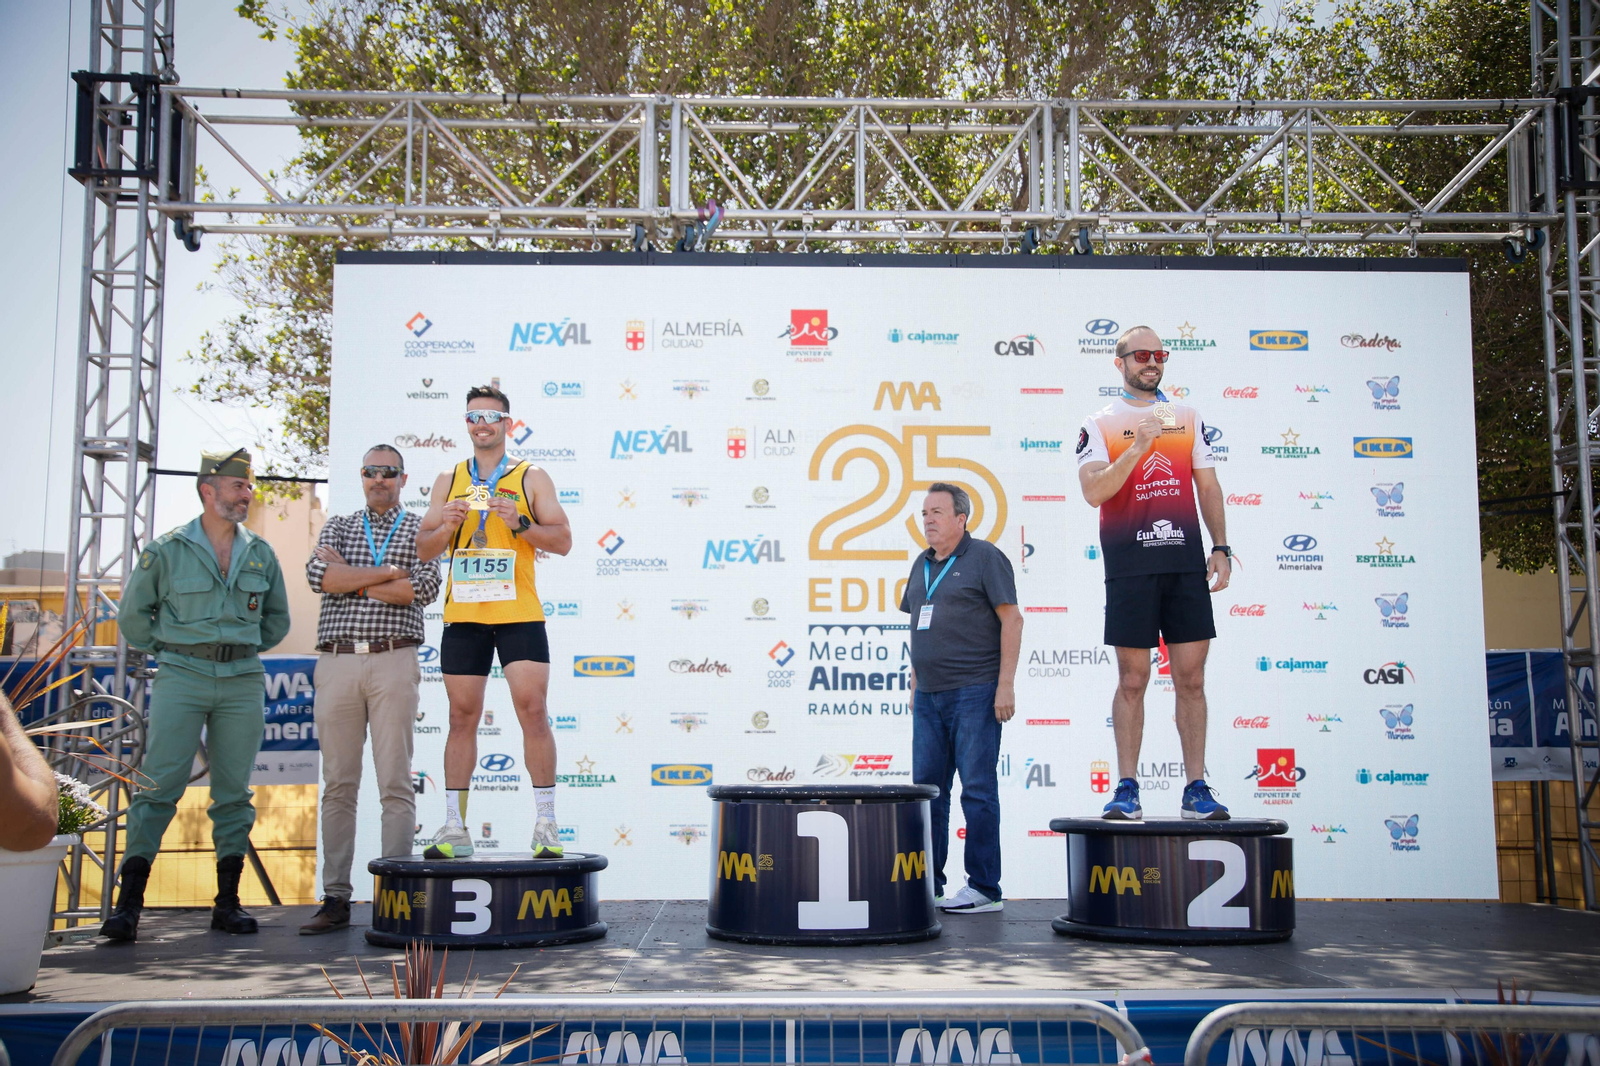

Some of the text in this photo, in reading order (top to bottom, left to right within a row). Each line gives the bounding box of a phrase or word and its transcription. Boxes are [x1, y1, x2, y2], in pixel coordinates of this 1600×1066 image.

[662, 319, 744, 337] ALMERÍA
[509, 317, 592, 351] NEXAL
[907, 329, 960, 345] cajamar
[404, 339, 475, 349] COOPERACIÓN
[661, 339, 704, 349] CIUDAD
[1257, 335, 1303, 345] IKEA
[993, 341, 1035, 356] CASI
[404, 350, 428, 358] 2005
[406, 391, 449, 400] vellsam
[610, 424, 693, 459] NEXAL
[1261, 446, 1321, 455] ESTRELLA
[1361, 443, 1406, 453] IKEA
[808, 424, 1009, 561] 25
[702, 534, 786, 569] NEXAL
[596, 558, 667, 567] COOPERACIÓN
[1276, 554, 1324, 562] HYUNDAI
[1356, 555, 1416, 564] ESTRELLA
[460, 558, 508, 574] 1155
[1278, 563, 1323, 571] Almerialva
[596, 568, 620, 576] 2005
[809, 641, 889, 661] Medio
[1028, 647, 1110, 665] ALMERÍA
[582, 662, 628, 672] IKEA
[1276, 658, 1328, 672] cajamar
[1028, 668, 1070, 678] CIUDAD
[1363, 668, 1404, 684] CASI
[768, 680, 792, 688] 2005
[808, 700, 910, 715] RAMÓN RUI
[472, 774, 520, 782] HYUNDAI
[556, 774, 616, 783] ESTRELLA
[660, 770, 706, 780] IKEA
[1376, 770, 1430, 785] cajamar
[473, 784, 520, 792] Almerialva
[797, 811, 869, 930] 1
[1143, 867, 1161, 880] 25
[1187, 840, 1250, 928] 2
[450, 878, 492, 935] 3
